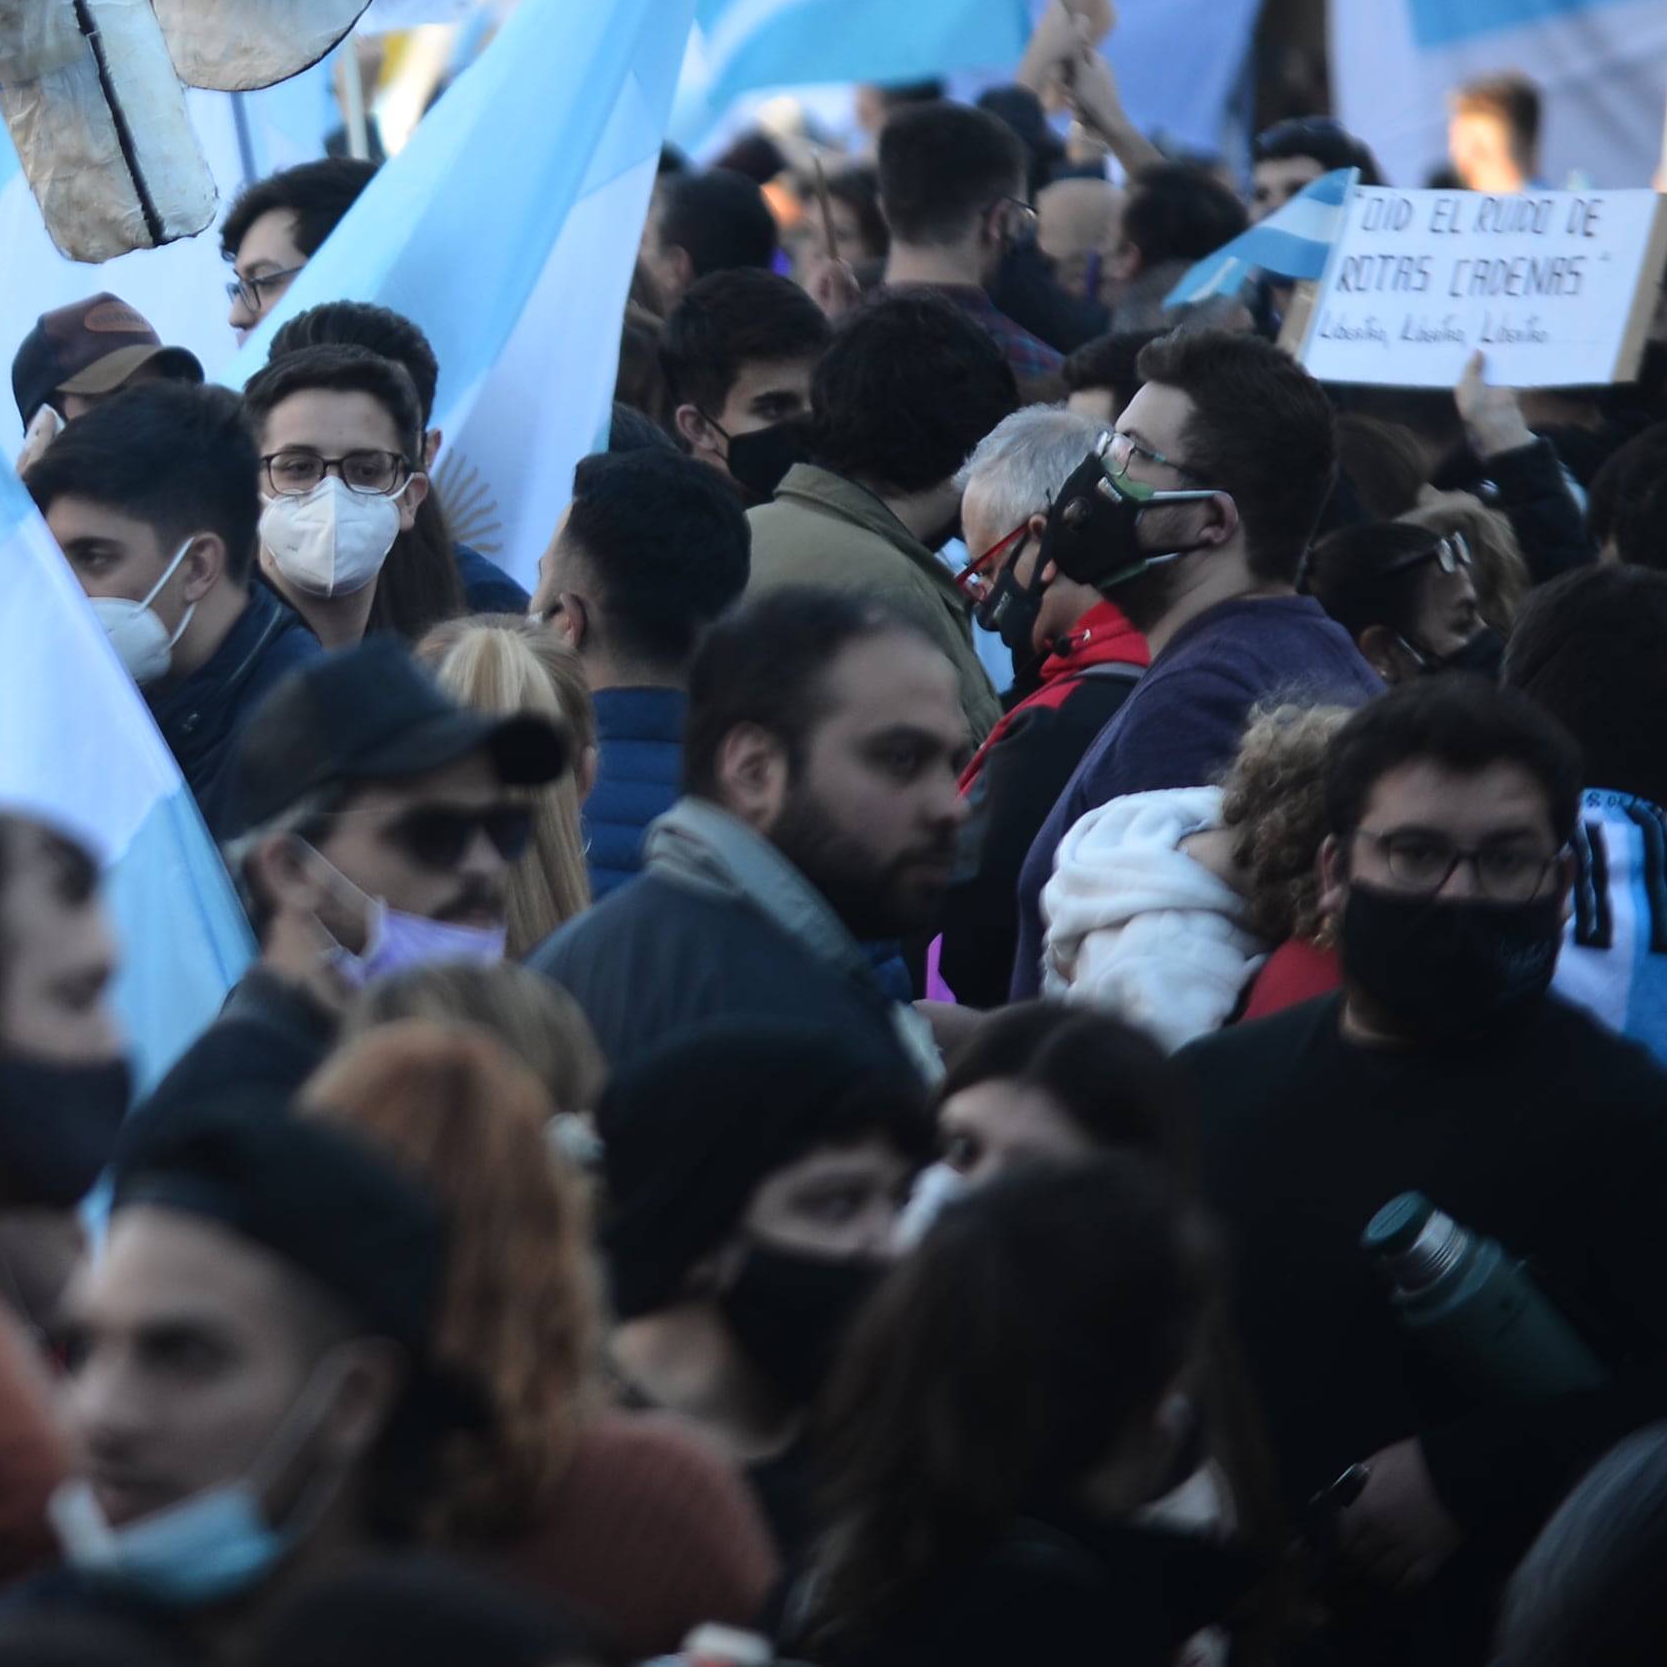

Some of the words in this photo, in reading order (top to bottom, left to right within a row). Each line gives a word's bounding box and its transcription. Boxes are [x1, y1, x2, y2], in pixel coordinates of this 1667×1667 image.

[1429, 198, 1463, 234] EL
[1565, 198, 1605, 238] DE
[1335, 253, 1435, 293] ROTAS
